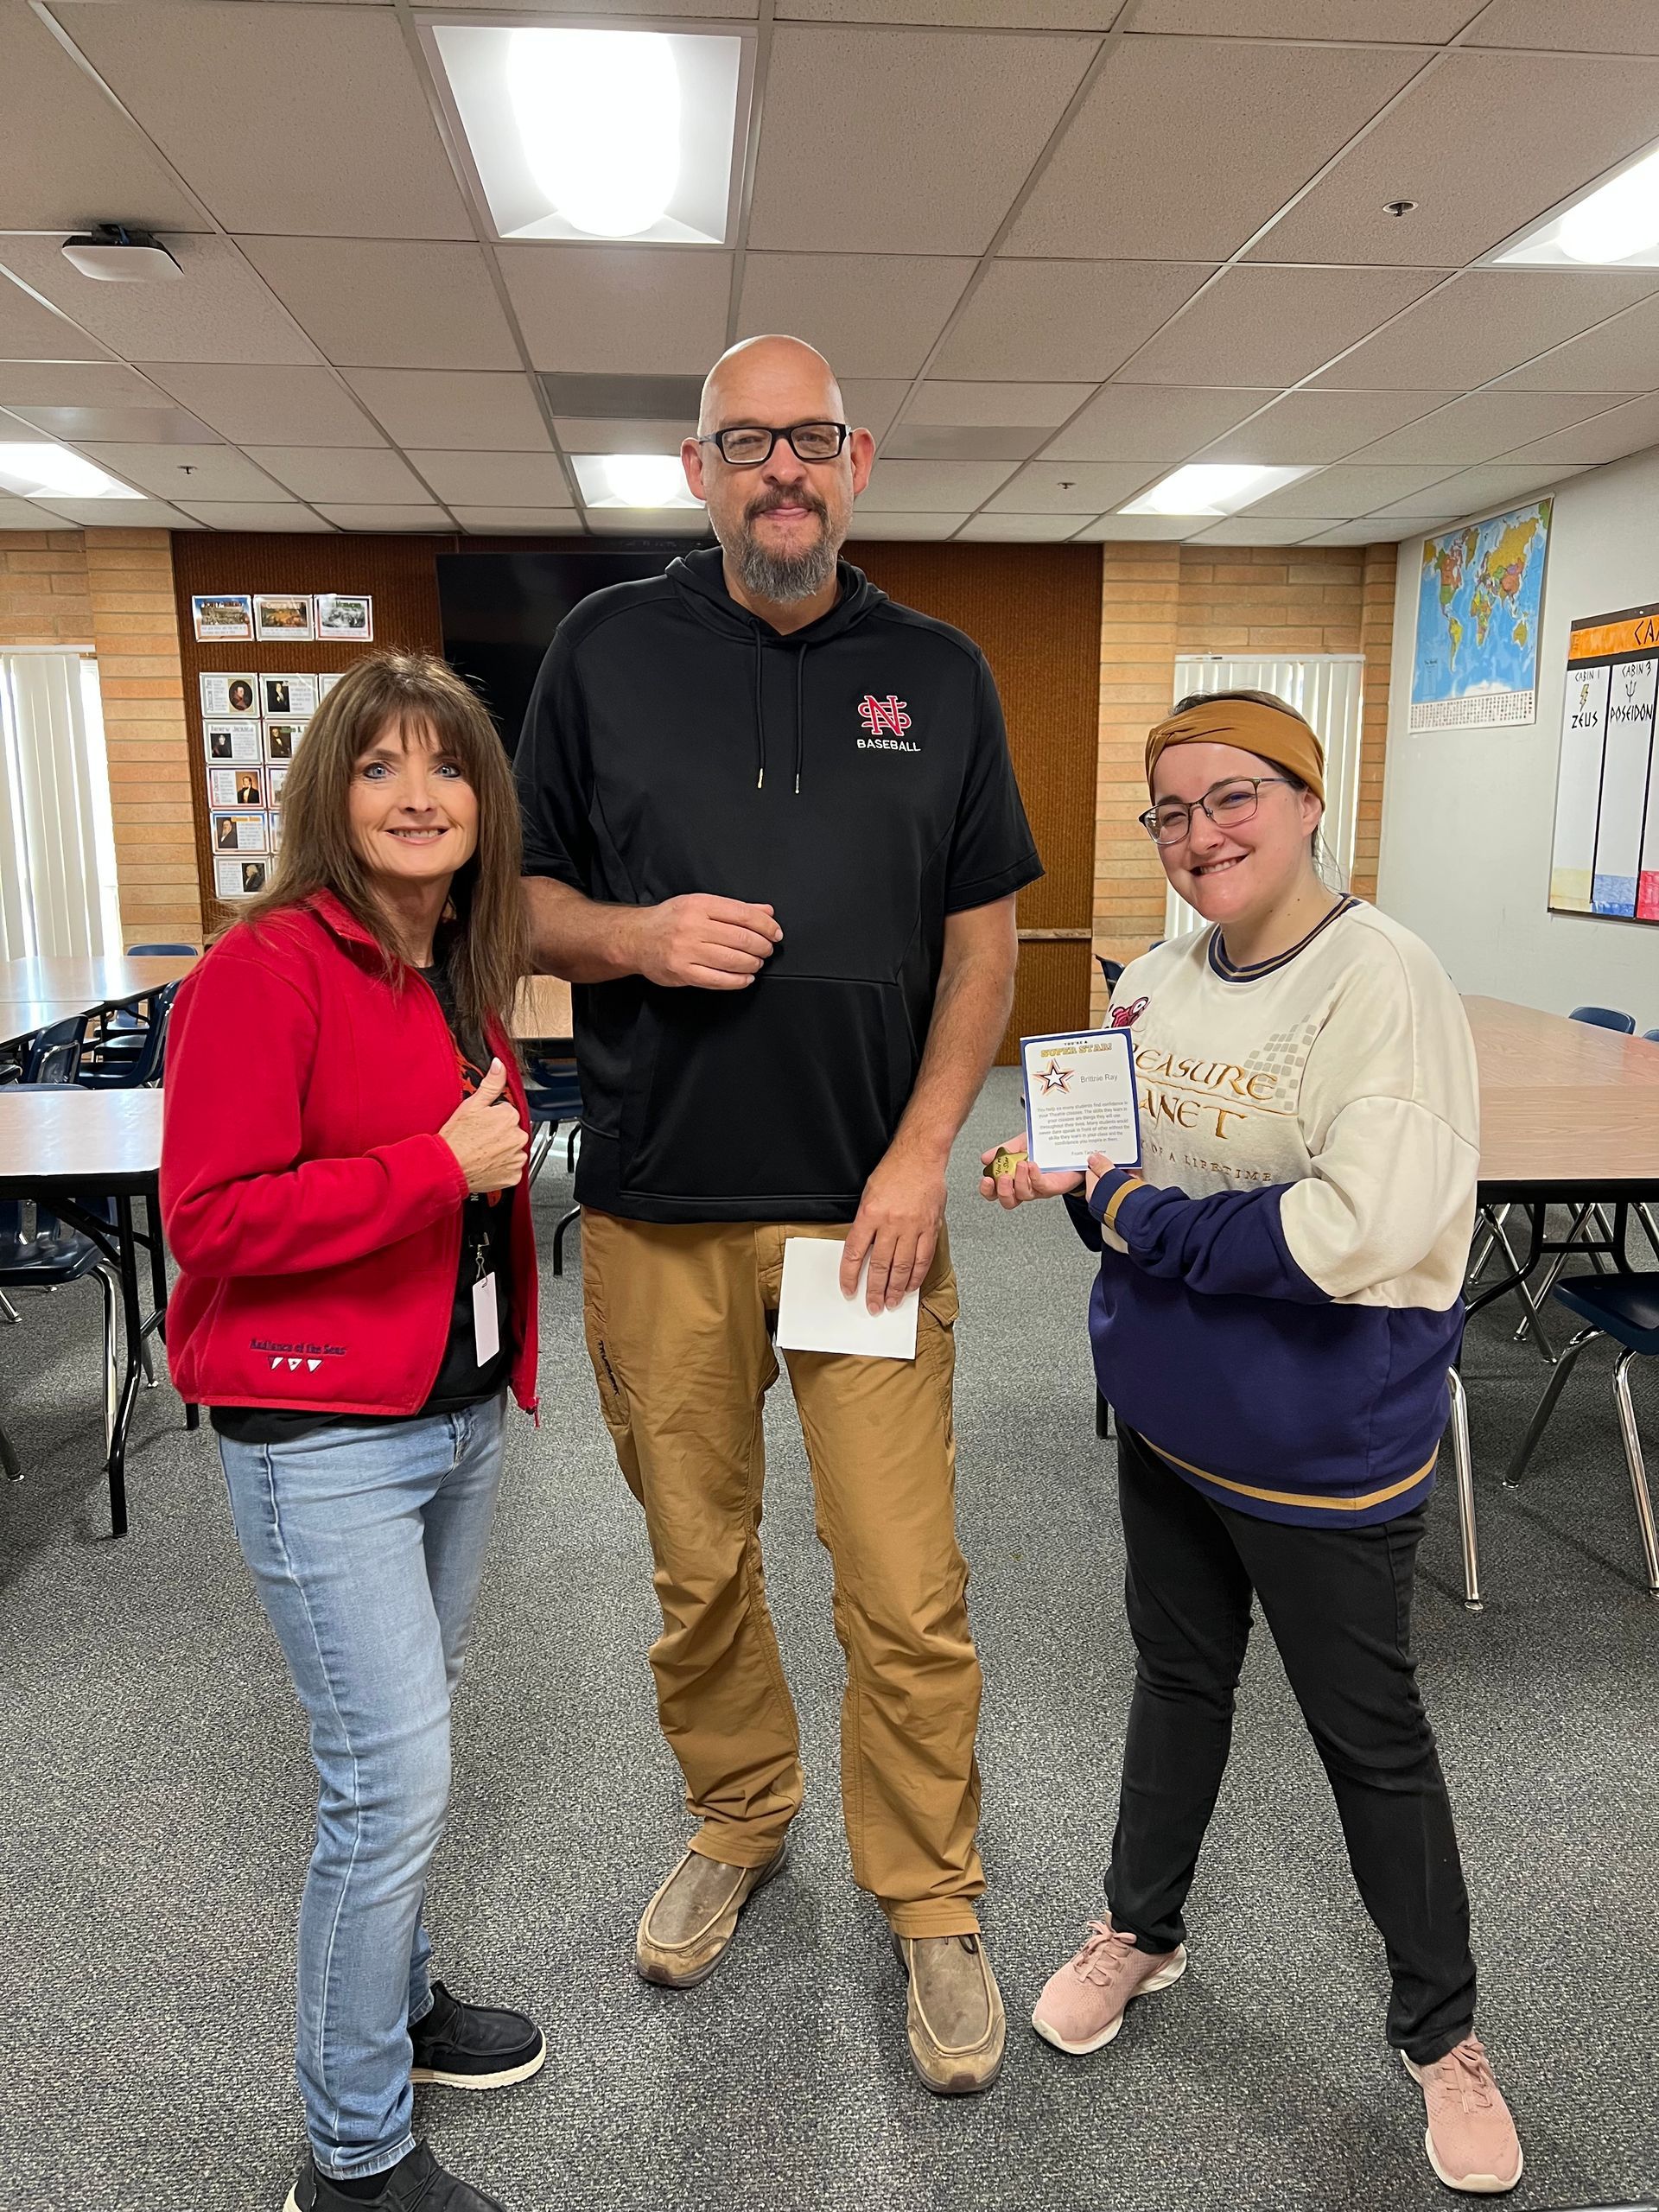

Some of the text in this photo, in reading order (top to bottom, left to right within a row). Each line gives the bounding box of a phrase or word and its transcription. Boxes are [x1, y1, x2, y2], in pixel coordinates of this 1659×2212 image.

[1634, 619, 1659, 645] CA
[1575, 670, 1594, 682] CABIN
[1622, 661, 1652, 677] CABIN 3
[1572, 711, 1598, 728] ZEUS
[1611, 703, 1653, 723] POSEIDON
[856, 739, 921, 752] BASEBALL
[1040, 1042, 1113, 1058] SUPER STAR!
[1104, 1073, 1118, 1082] Ray
[1133, 1043, 1279, 1101] EASURE
[1139, 1089, 1248, 1140] ANET
[1169, 1151, 1176, 1162] A
[1184, 1154, 1272, 1182] LIFETIME
